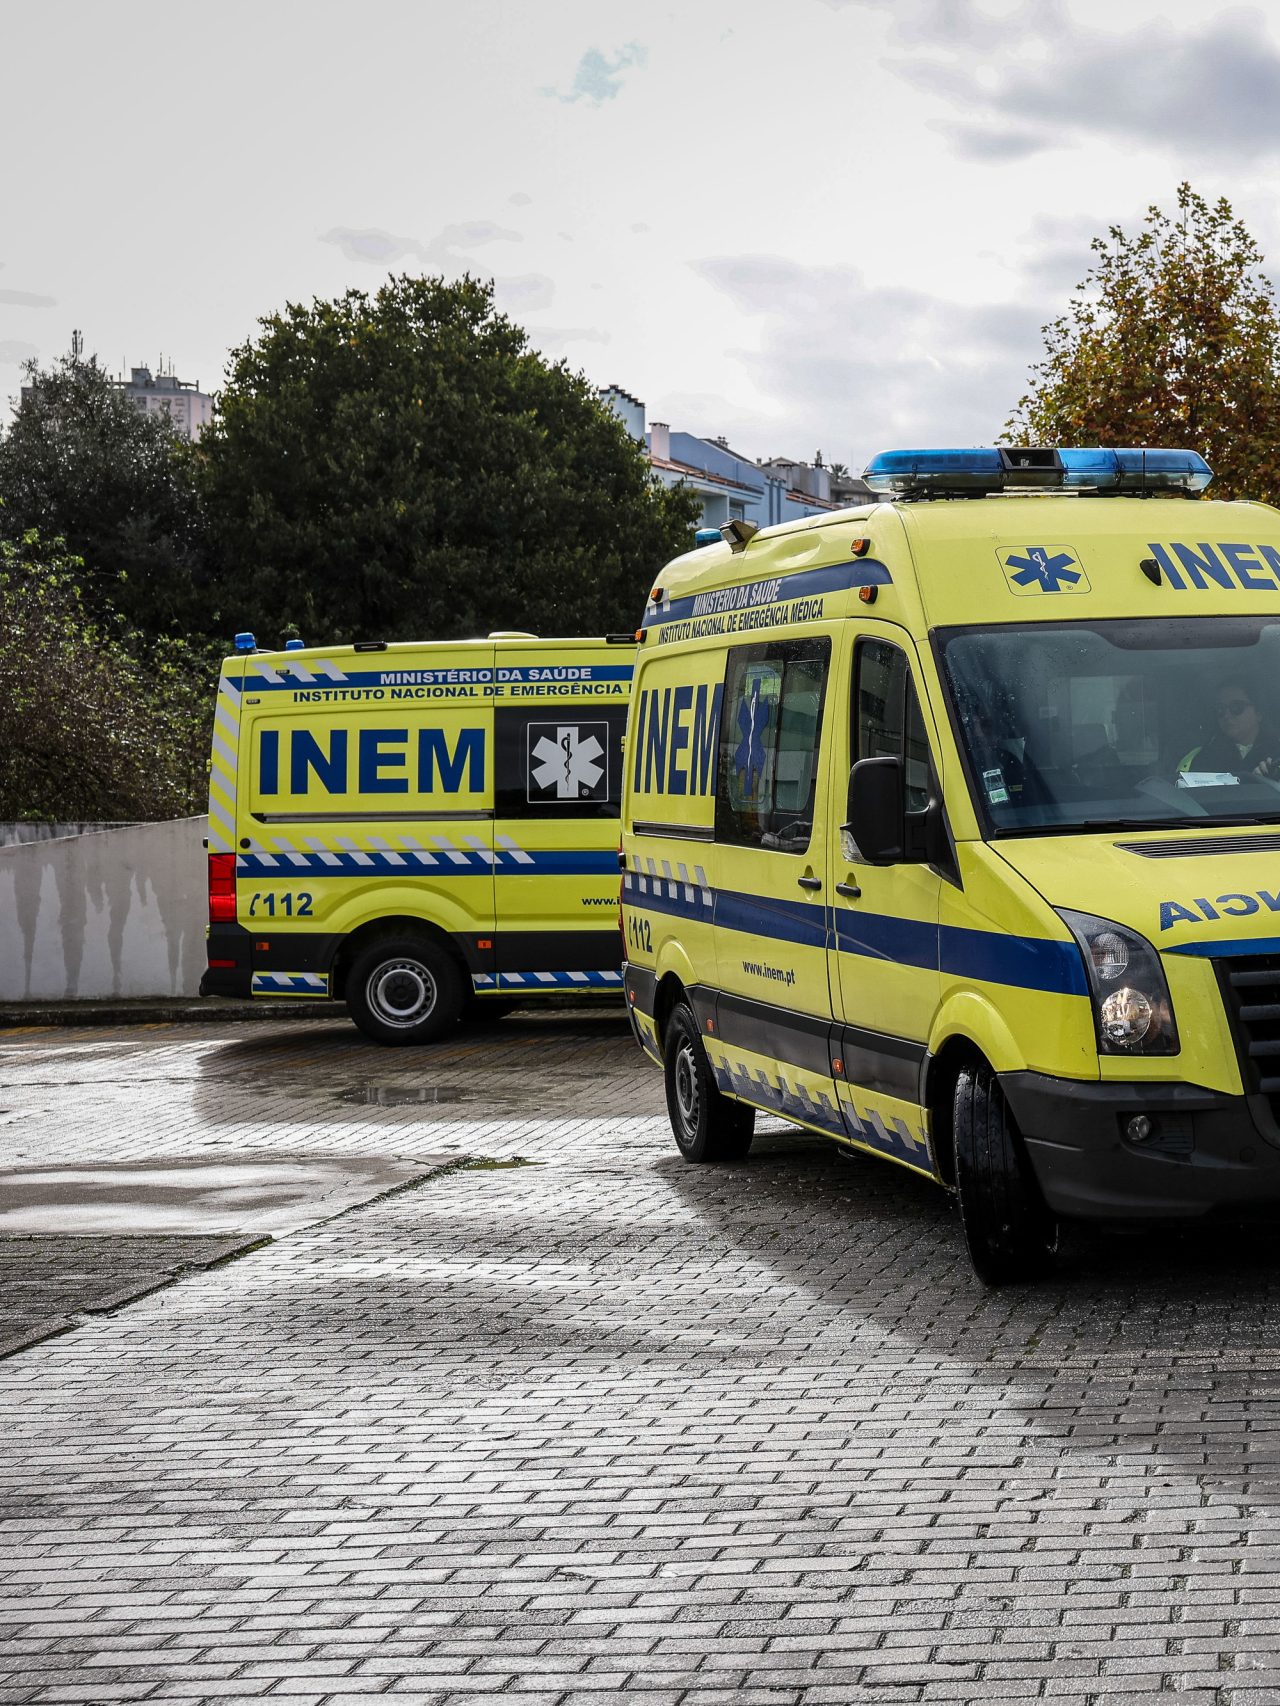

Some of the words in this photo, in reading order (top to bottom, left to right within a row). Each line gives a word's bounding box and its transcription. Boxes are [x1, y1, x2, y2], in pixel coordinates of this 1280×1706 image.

[737, 586, 749, 609] DA
[659, 622, 691, 645] INSTITUTO
[692, 616, 725, 639] NACIONAL
[727, 613, 737, 633] DE
[791, 598, 824, 623] MÉDICA
[380, 669, 492, 685] MINISTÉRIO
[498, 669, 523, 682] DA
[528, 666, 592, 681] SAÚDE
[293, 689, 385, 703] INSTITUTO
[390, 686, 479, 699] NACIONAL
[483, 685, 505, 697] DE
[510, 683, 623, 696] EMERGÊNCIA
[633, 683, 724, 797] INEM
[259, 728, 486, 795] INEM
[262, 892, 314, 917] 112
[632, 916, 653, 953] 112
[742, 961, 796, 987] www.inem.pt
